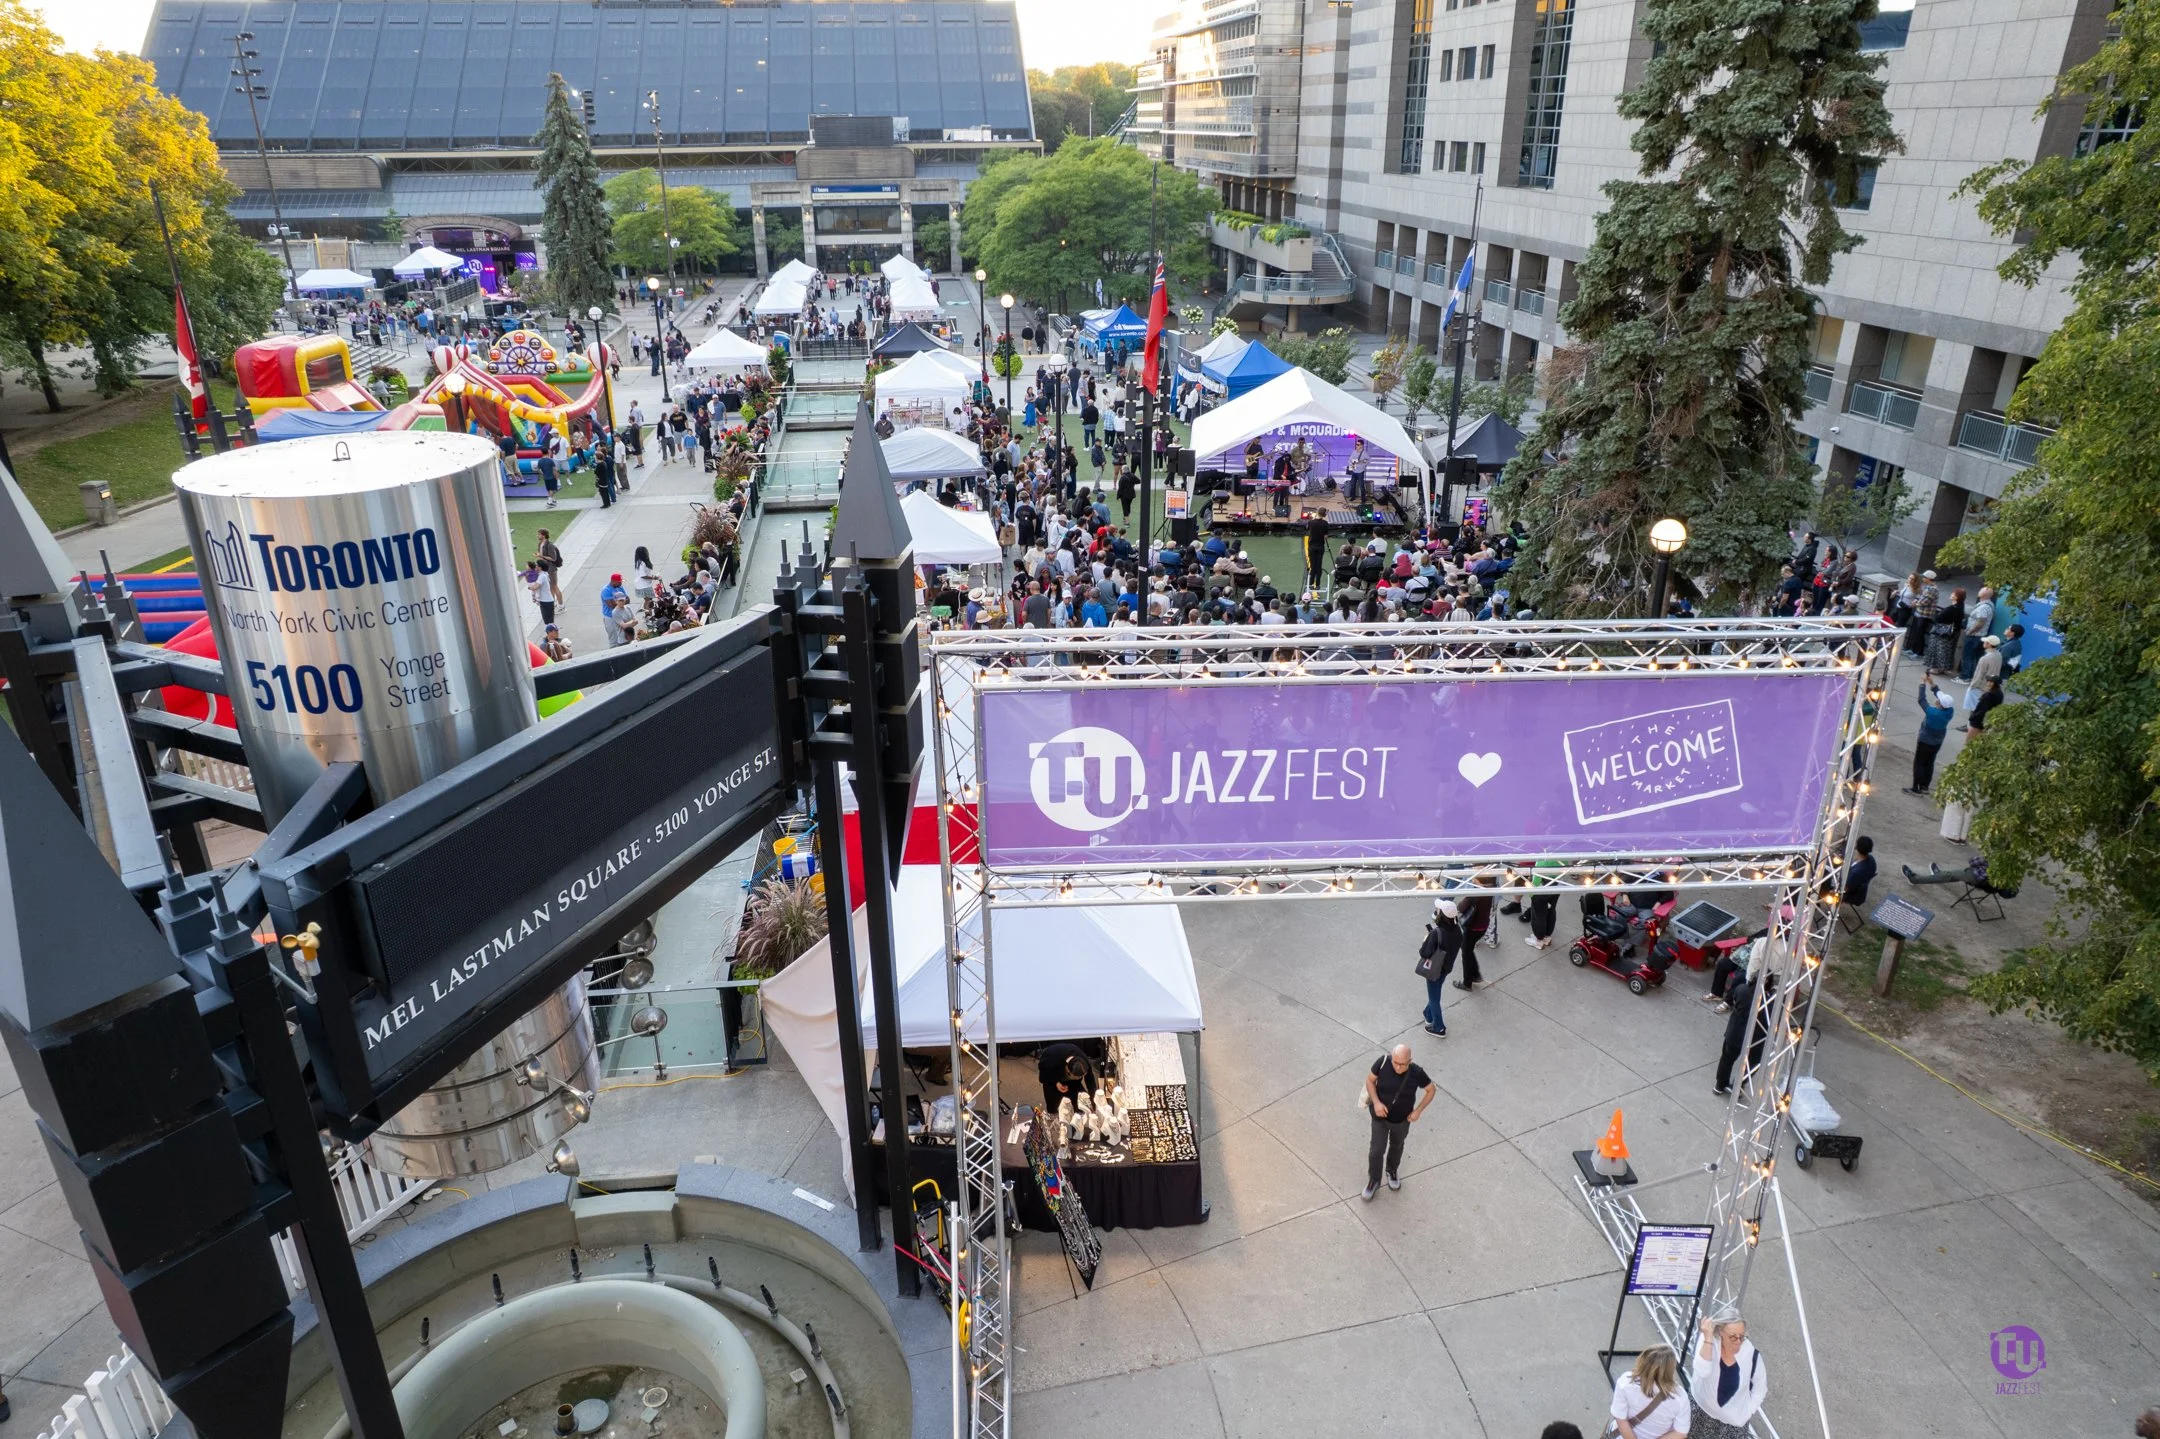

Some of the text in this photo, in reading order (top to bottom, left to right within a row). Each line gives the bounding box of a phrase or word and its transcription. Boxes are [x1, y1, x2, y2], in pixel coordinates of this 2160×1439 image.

[1277, 425, 1286, 436] &
[222, 595, 449, 634] North York Civic Centre
[379, 651, 446, 679] Yonge
[246, 660, 364, 715] 5100
[387, 676, 451, 708] Street
[1631, 724, 1675, 744] THE
[1582, 725, 1726, 789] WELCOME
[1631, 767, 1691, 794] MARKET
[363, 747, 777, 1050] MEL LASTMAN SQUARE 5100 YONGE ST.
